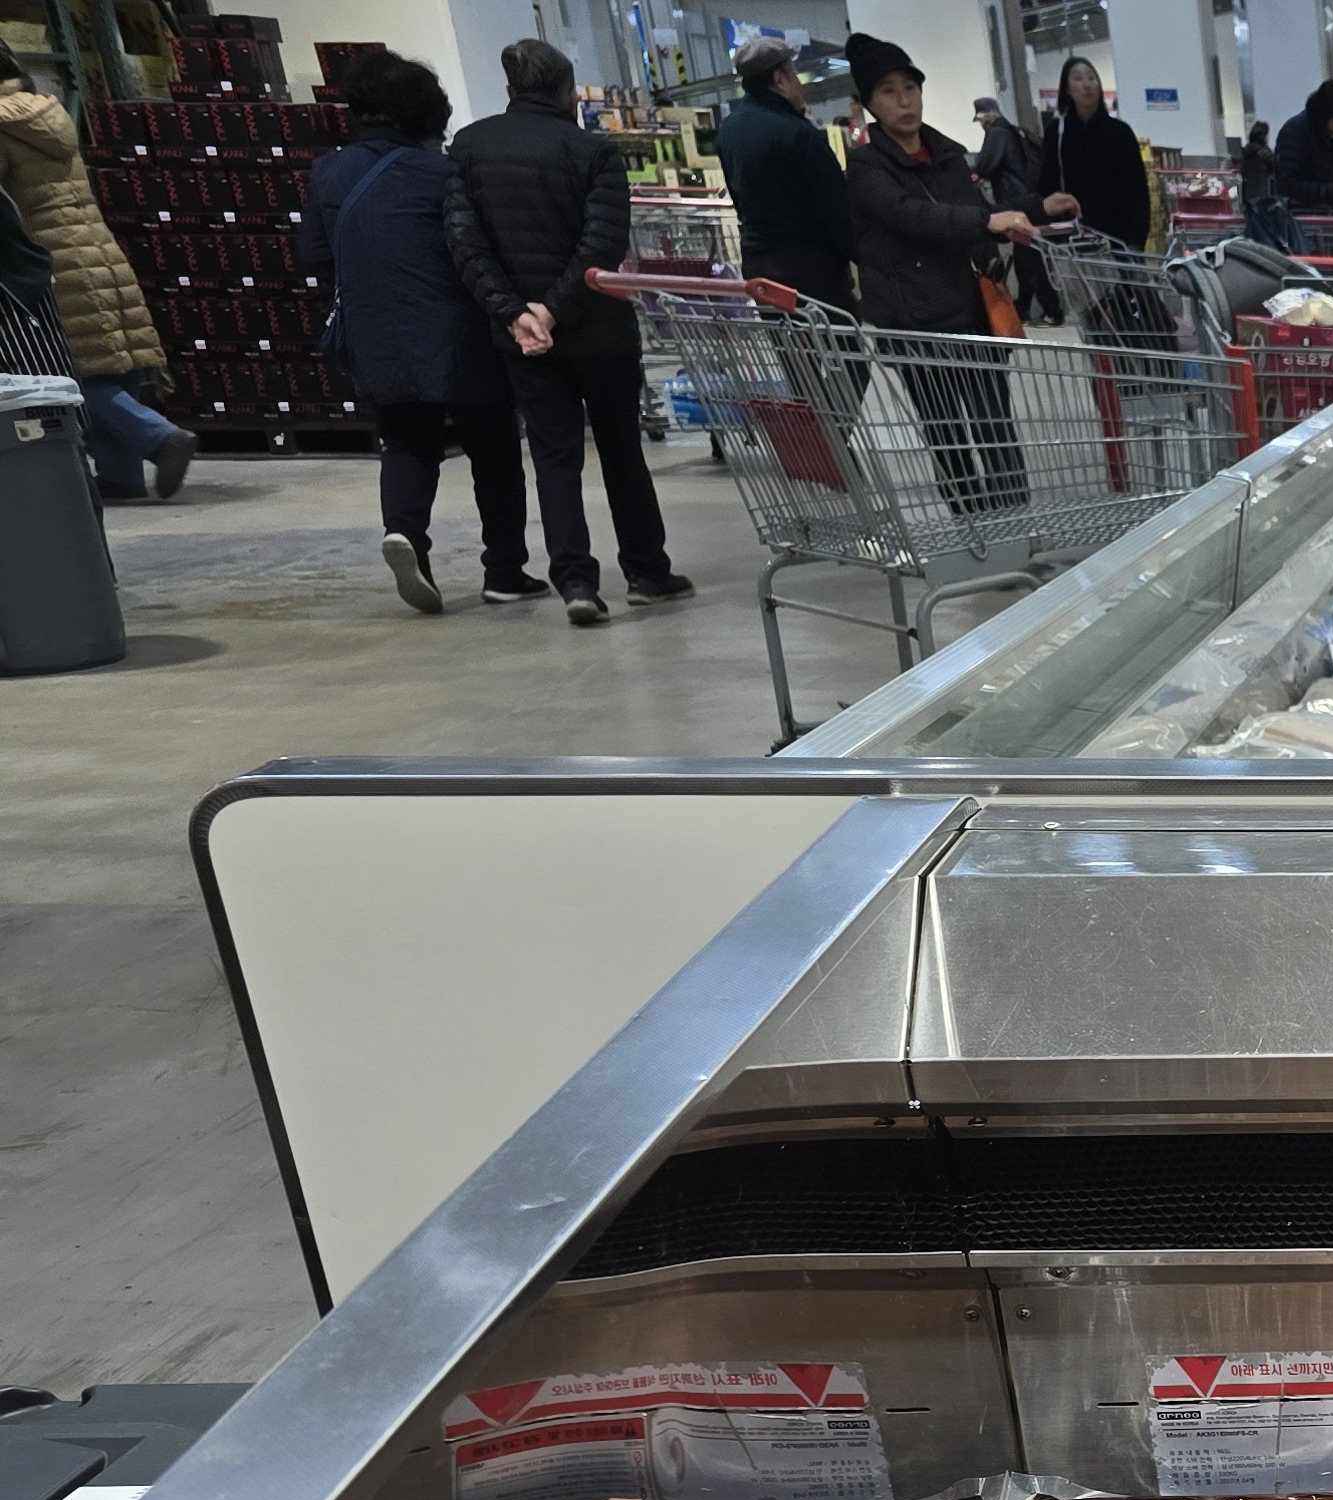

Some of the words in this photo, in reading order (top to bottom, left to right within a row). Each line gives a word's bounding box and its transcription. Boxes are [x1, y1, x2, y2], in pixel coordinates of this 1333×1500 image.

[1231, 1365, 1255, 1376] 아래
[1259, 1364, 1283, 1376] 표시
[1286, 1362, 1333, 1375] 선까지만
